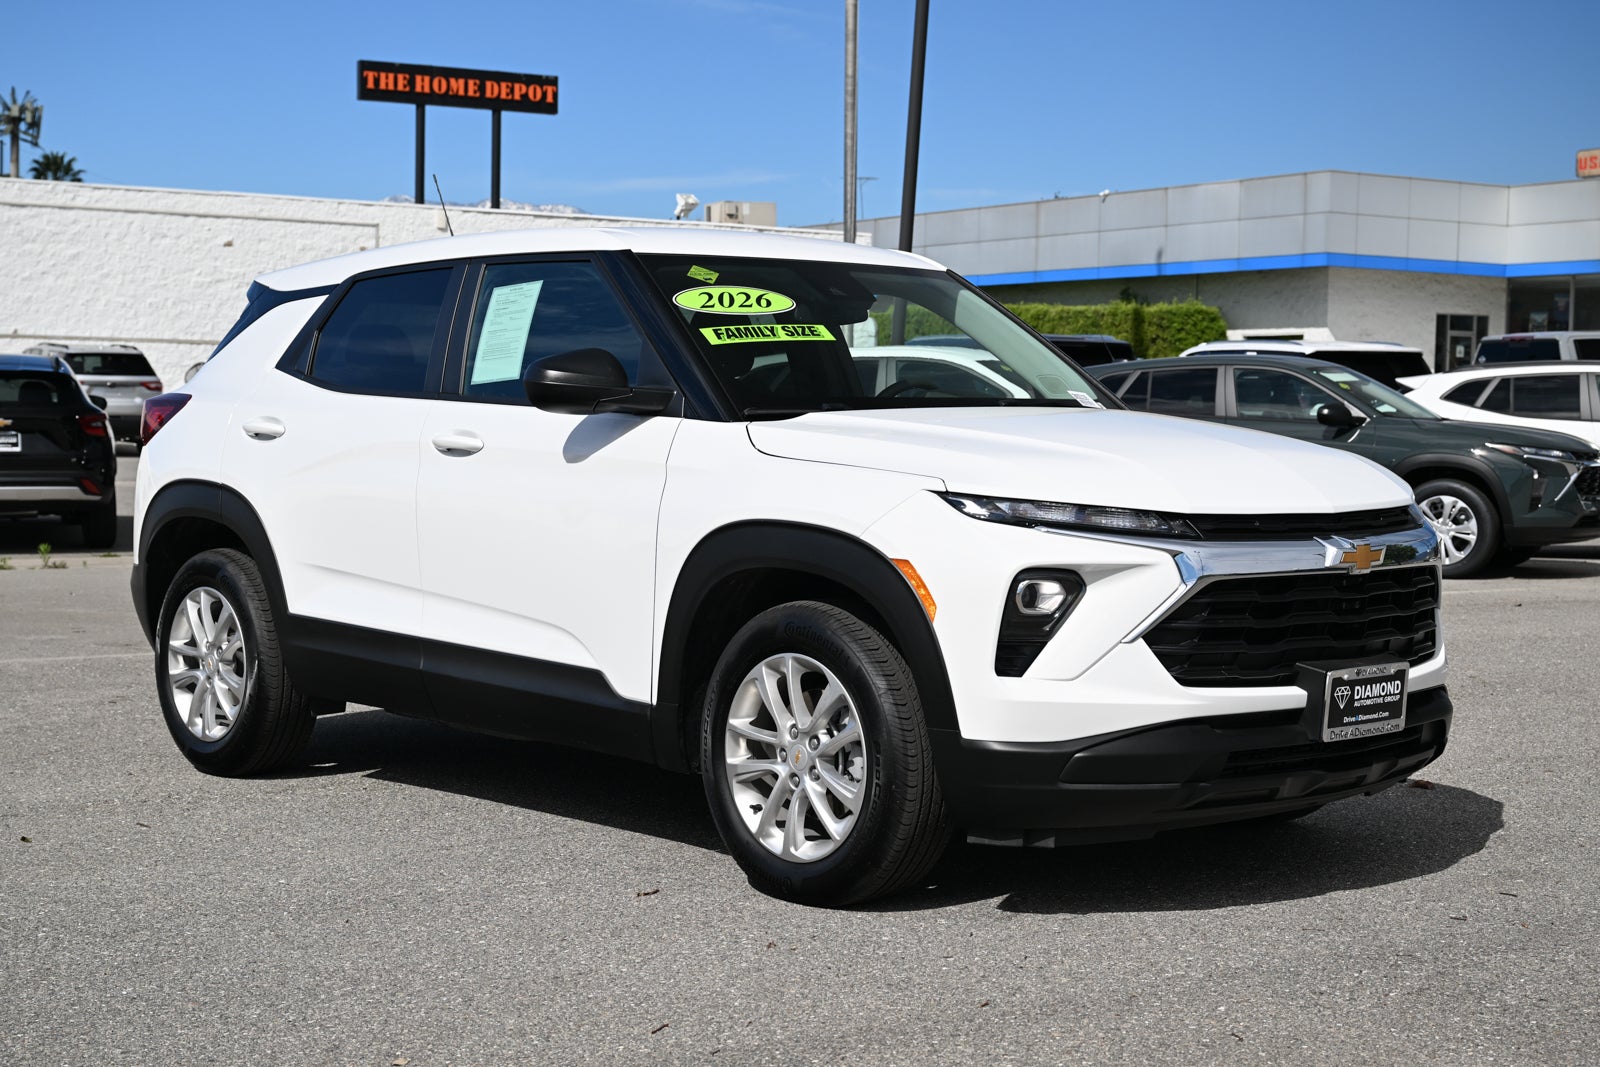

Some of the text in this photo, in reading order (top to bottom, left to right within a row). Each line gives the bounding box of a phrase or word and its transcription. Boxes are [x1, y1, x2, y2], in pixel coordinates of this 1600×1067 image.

[363, 70, 557, 103] THE HOME DEPOT
[1579, 154, 1600, 167] US
[697, 291, 772, 309] 2026
[712, 325, 822, 340] FAMILY SIZE
[784, 621, 845, 657] Continental
[1354, 680, 1402, 700] DIAMOND
[1354, 694, 1401, 707] AUTOMOTIVE GROUP
